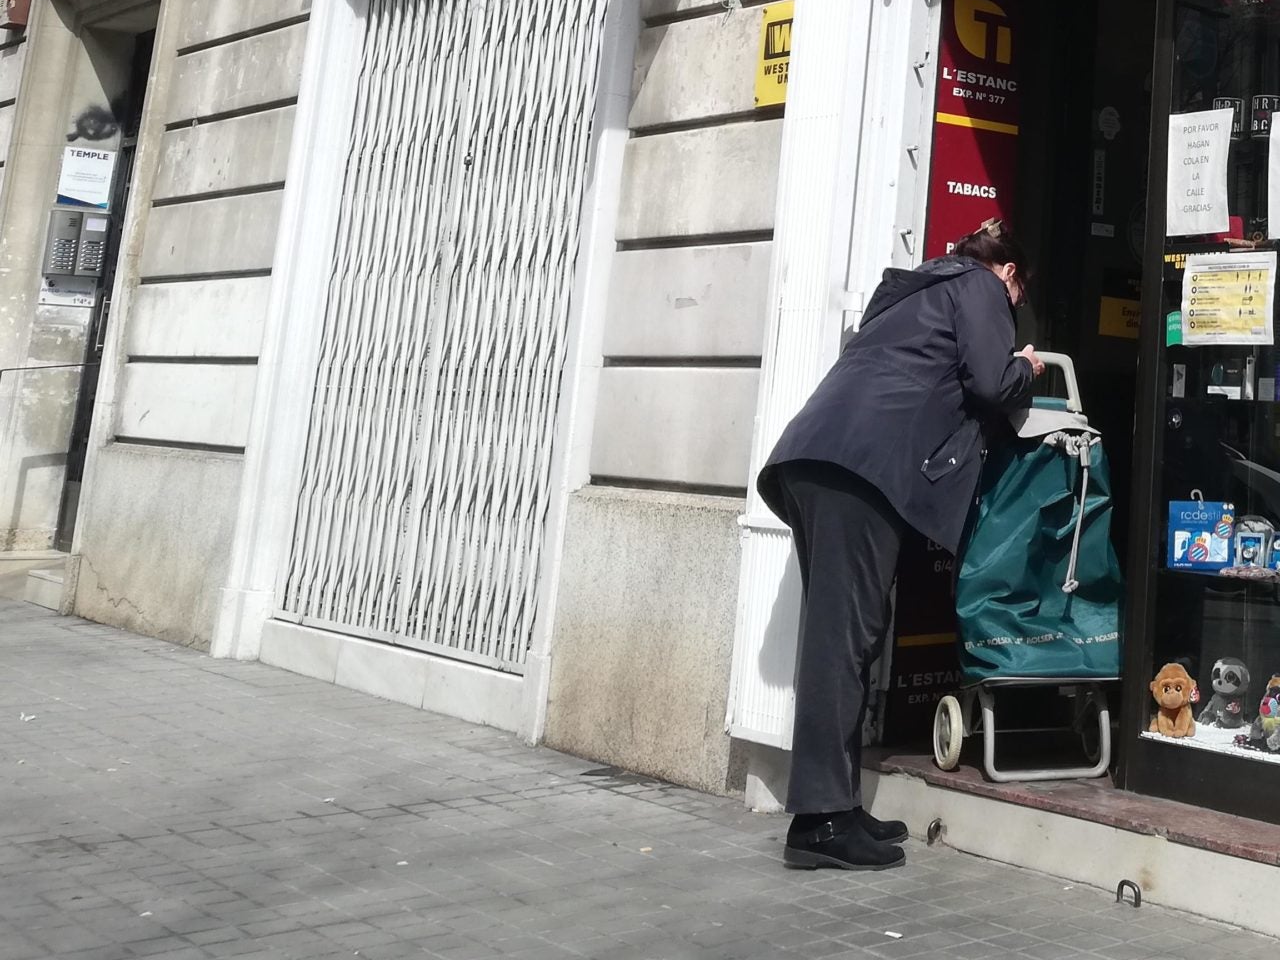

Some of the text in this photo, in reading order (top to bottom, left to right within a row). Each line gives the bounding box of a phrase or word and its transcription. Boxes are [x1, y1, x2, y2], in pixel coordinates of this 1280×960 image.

[764, 62, 790, 76] WEST
[953, 87, 973, 99] EXP.
[989, 94, 1005, 105] 377
[1183, 123, 1219, 134] POR FAVOR
[1188, 140, 1210, 149] HAGAN
[70, 149, 109, 161] TEMPLE
[1183, 155, 1209, 166] COLA EN
[1192, 172, 1200, 181] LA
[947, 181, 997, 198] TABACS
[1186, 187, 1205, 197] CALLE
[1164, 253, 1185, 263] WEST
